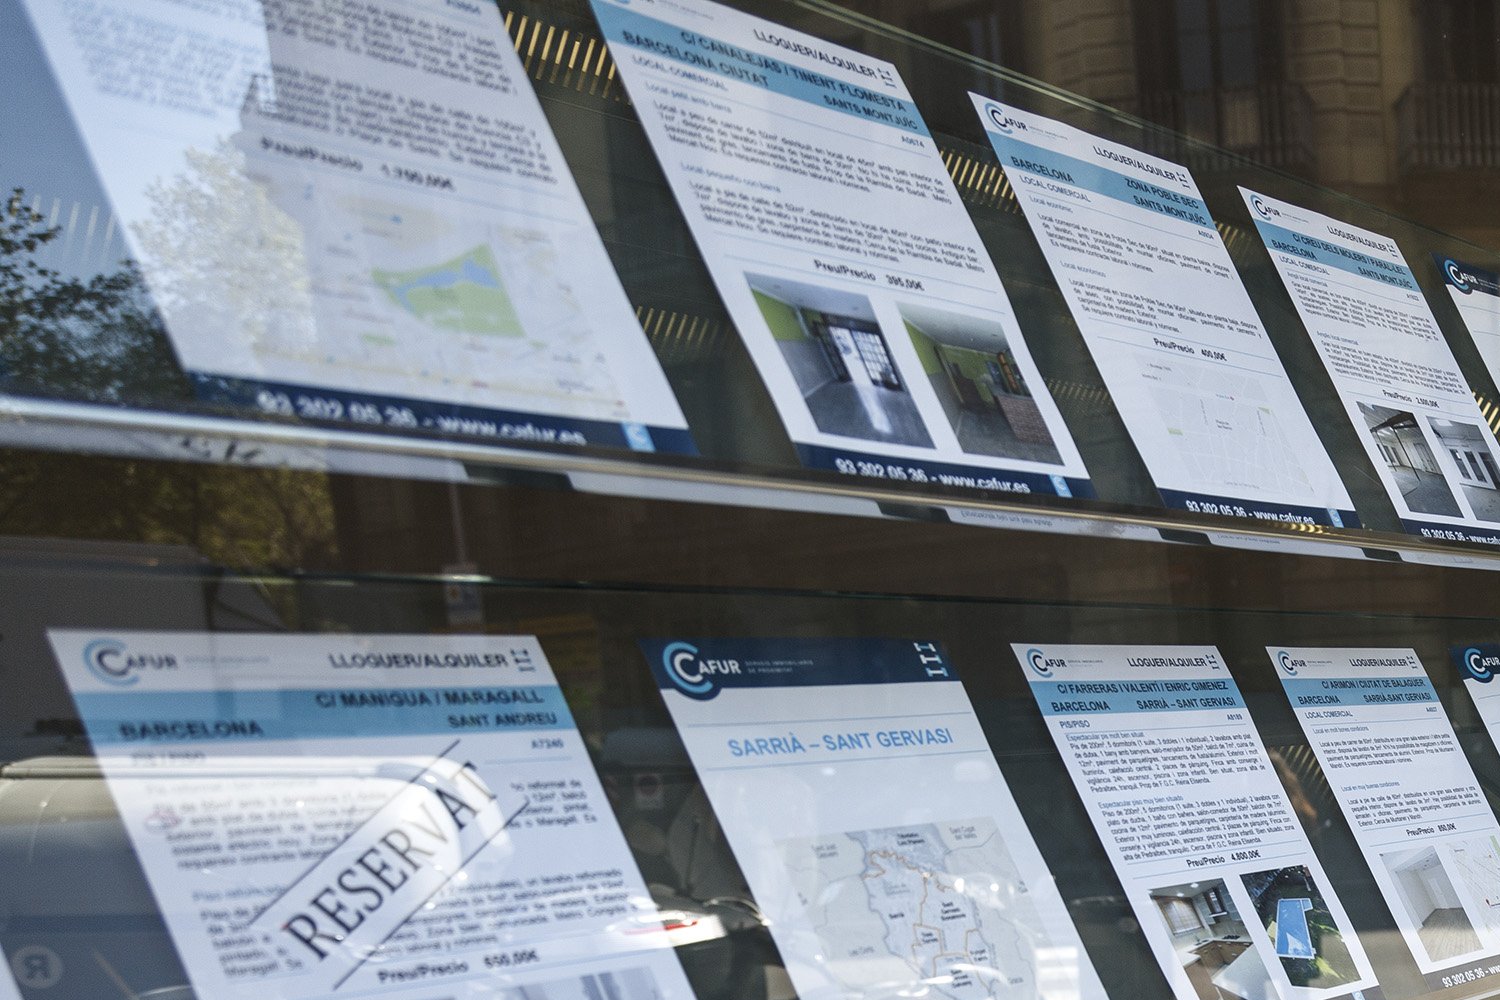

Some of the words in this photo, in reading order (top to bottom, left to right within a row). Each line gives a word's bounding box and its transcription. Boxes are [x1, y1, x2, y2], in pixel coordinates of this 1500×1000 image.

[697, 36, 783, 75] CANALEJAS
[752, 28, 877, 79] LLOGUER/ALQUILER
[621, 30, 718, 72] BARCELONA
[717, 61, 771, 87] CIUTAT
[821, 92, 863, 114] SANTS
[1092, 144, 1177, 182] LLOGUER/ALQUILER
[1010, 155, 1075, 184] BARCELONA
[1132, 194, 1163, 212] SANTS
[1018, 174, 1048, 190] LOCAL
[1046, 182, 1091, 203] COMERCIAL
[1124, 178, 1152, 195] ZONA
[1150, 186, 1181, 204] POBLE
[1179, 196, 1199, 209] SEC
[1270, 238, 1317, 260] BARCELONA
[1251, 507, 1316, 525] www.cafur.es
[326, 652, 510, 669] LLOGUER/ALQUILER
[674, 653, 742, 683] CAFUR
[1126, 657, 1208, 668] LLOGUER/ALQUILER
[1348, 659, 1409, 667] LLOGUER/ALQUILER
[1055, 683, 1069, 694] C/
[1067, 683, 1119, 694] FARRERAS
[1121, 681, 1161, 692] VALENTÍ
[1163, 682, 1192, 691] ENRIC
[1189, 680, 1228, 691] GIMENEZ
[1328, 680, 1356, 689] ARIMON
[1358, 679, 1383, 688] CIUTAT
[442, 689, 544, 704] MARAGALL
[1050, 700, 1111, 712] BARCELONA
[1134, 697, 1170, 710] SARRIÀ
[1174, 698, 1201, 708] SANT
[1198, 697, 1237, 707] GERVASI
[1297, 695, 1341, 705] BARCELONA
[1403, 692, 1432, 701] GERVASI
[1058, 719, 1091, 728] PIS/PISO
[1322, 710, 1353, 718] COMERCIAL
[117, 720, 264, 741] BARCELONA
[445, 713, 497, 728] SANT
[496, 711, 559, 727] ANDREU
[728, 732, 805, 758] SARRIÀ
[822, 733, 871, 751] SANT
[877, 727, 953, 749] GERVASI
[281, 761, 497, 962] RESERVAT
[1185, 854, 1226, 869] Preu/Precio
[1229, 849, 1261, 862] 4.800,00€
